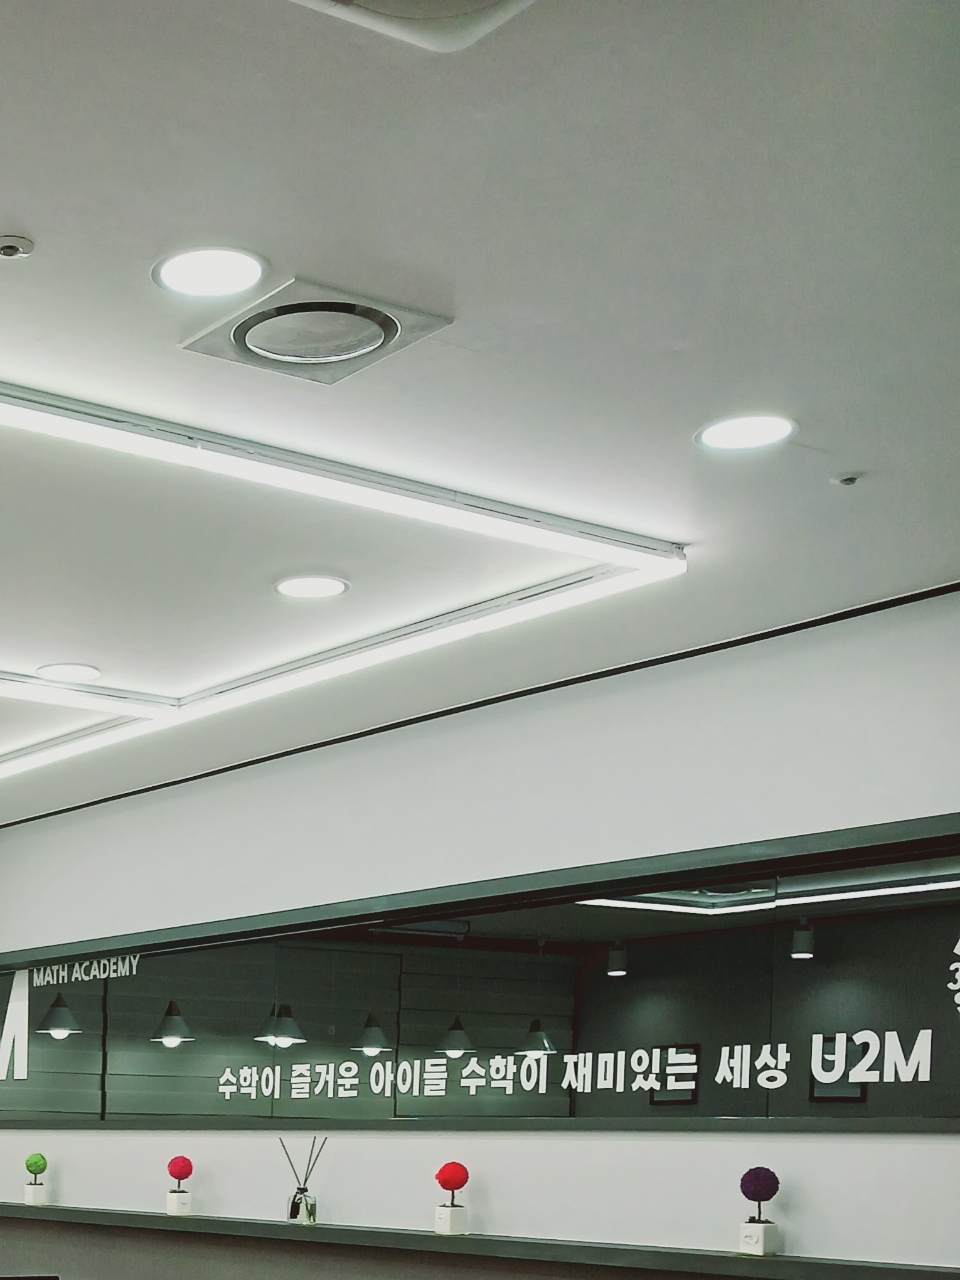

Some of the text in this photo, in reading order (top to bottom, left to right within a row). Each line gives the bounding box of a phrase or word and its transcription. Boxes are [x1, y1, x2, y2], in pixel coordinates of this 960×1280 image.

[33, 954, 140, 987] MATH ACADEMY
[218, 1029, 932, 1100] 수학이 즐거운 아이들 수학이 재미있는 세상 U2M
